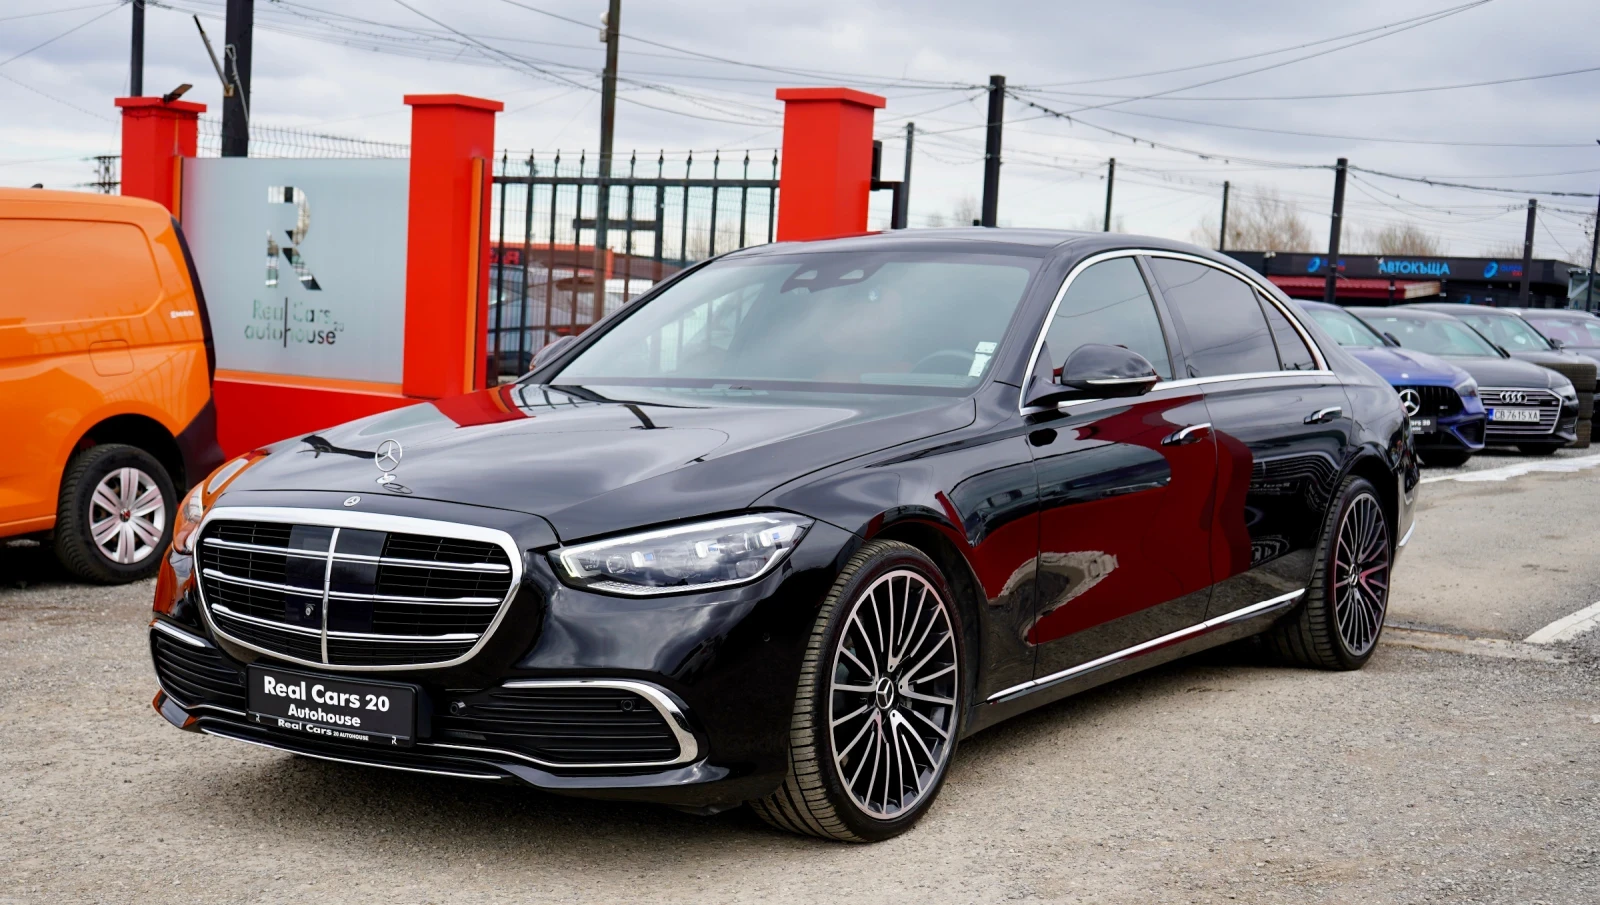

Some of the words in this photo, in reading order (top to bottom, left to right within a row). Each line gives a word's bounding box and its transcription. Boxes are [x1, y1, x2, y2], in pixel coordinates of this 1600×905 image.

[1379, 260, 1451, 276] АВТОКЪЩА
[1494, 410, 1506, 420] CB
[1507, 410, 1527, 420] 7615
[1528, 411, 1538, 420] XA
[263, 675, 307, 700] Real
[311, 684, 361, 709] Cars
[365, 694, 390, 712] 20
[288, 703, 361, 727] Autohouse
[277, 718, 302, 731] Real
[305, 724, 333, 736] Cars
[339, 731, 369, 741] AUTOHOUSE
